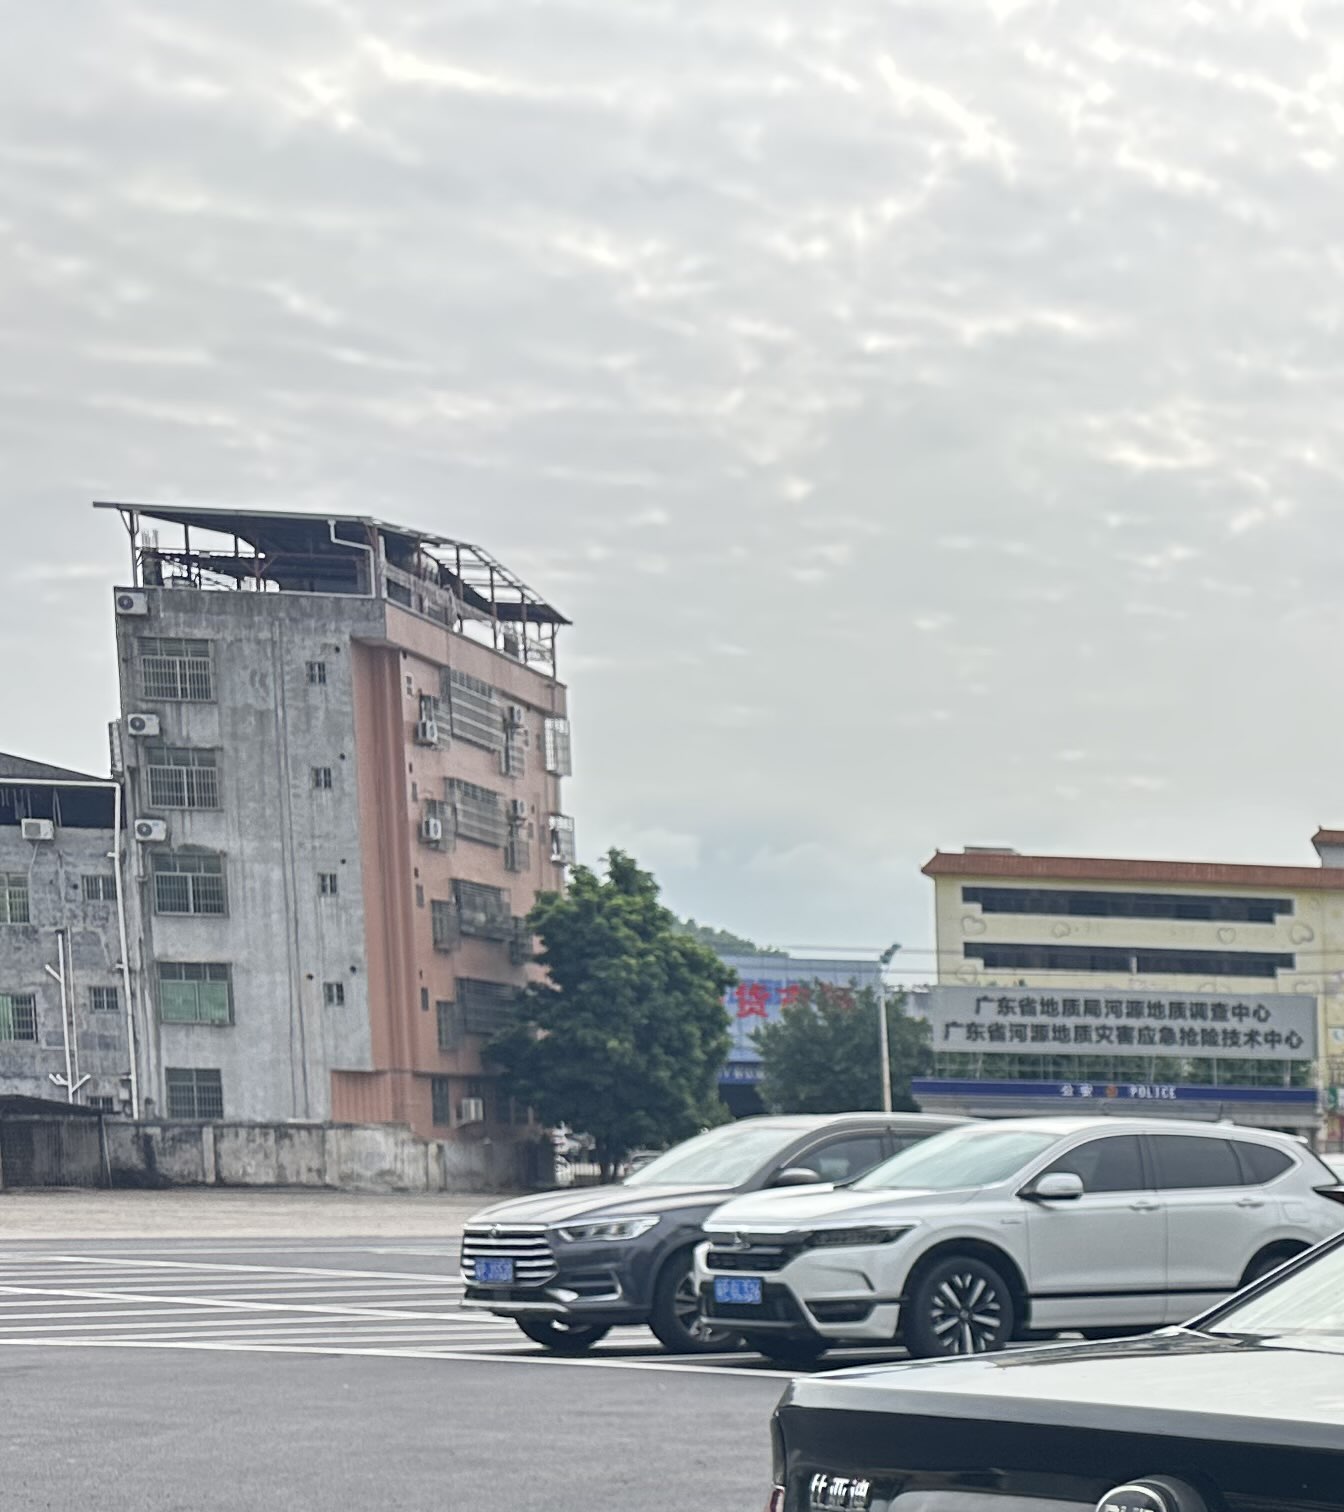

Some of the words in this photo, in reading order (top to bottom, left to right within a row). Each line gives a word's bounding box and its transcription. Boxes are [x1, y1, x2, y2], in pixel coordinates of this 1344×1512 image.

[974, 995, 1272, 1024] 广东省地质局河源地质调查中心
[1129, 1084, 1177, 1099] POLICE
